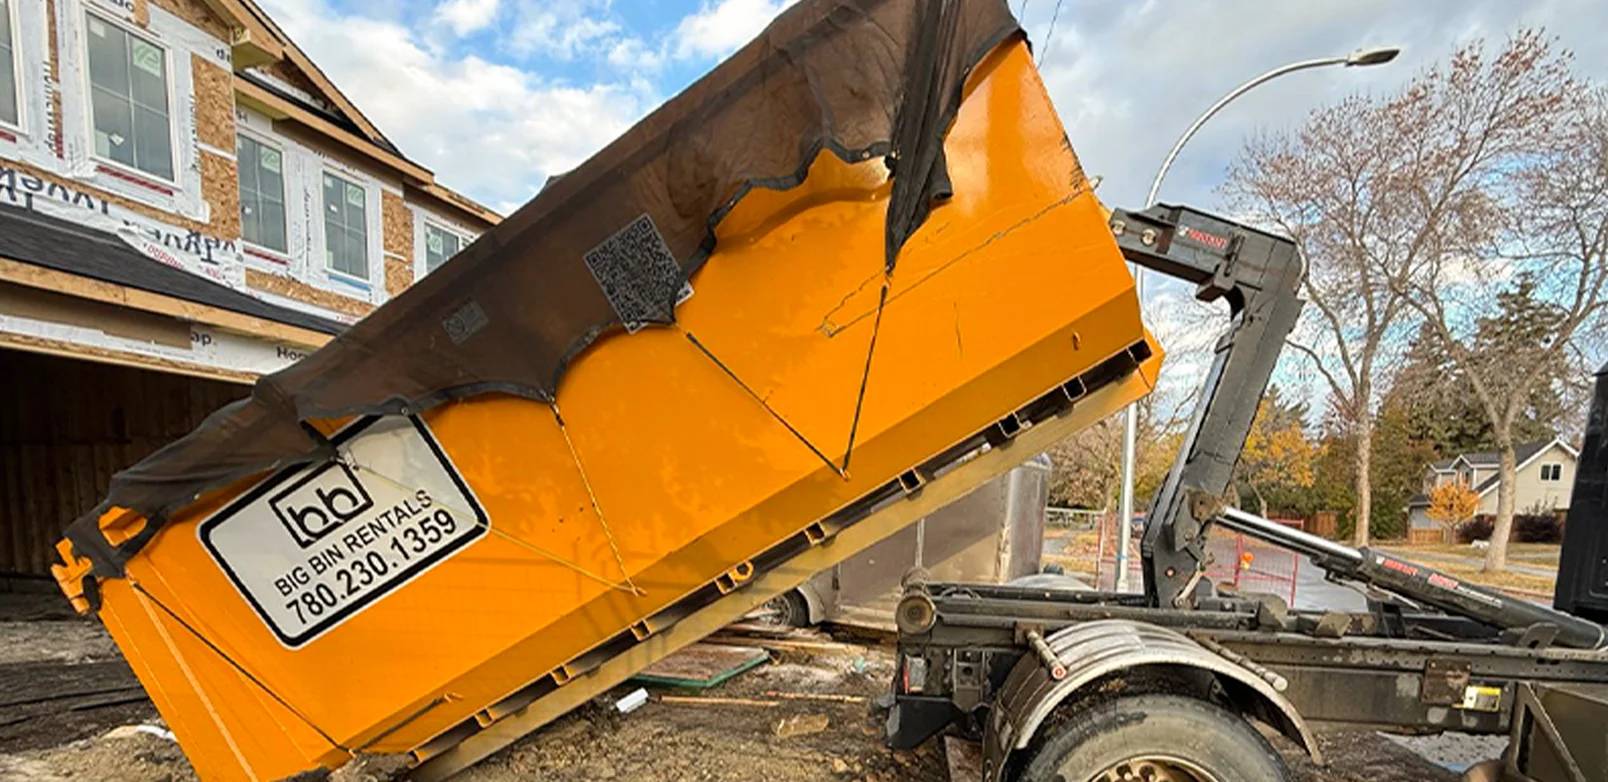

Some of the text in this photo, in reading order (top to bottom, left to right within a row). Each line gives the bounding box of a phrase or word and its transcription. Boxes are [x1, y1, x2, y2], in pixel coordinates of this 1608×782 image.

[274, 489, 433, 597] BIG BIN RENTALS
[286, 508, 458, 626] 780.230.1359
